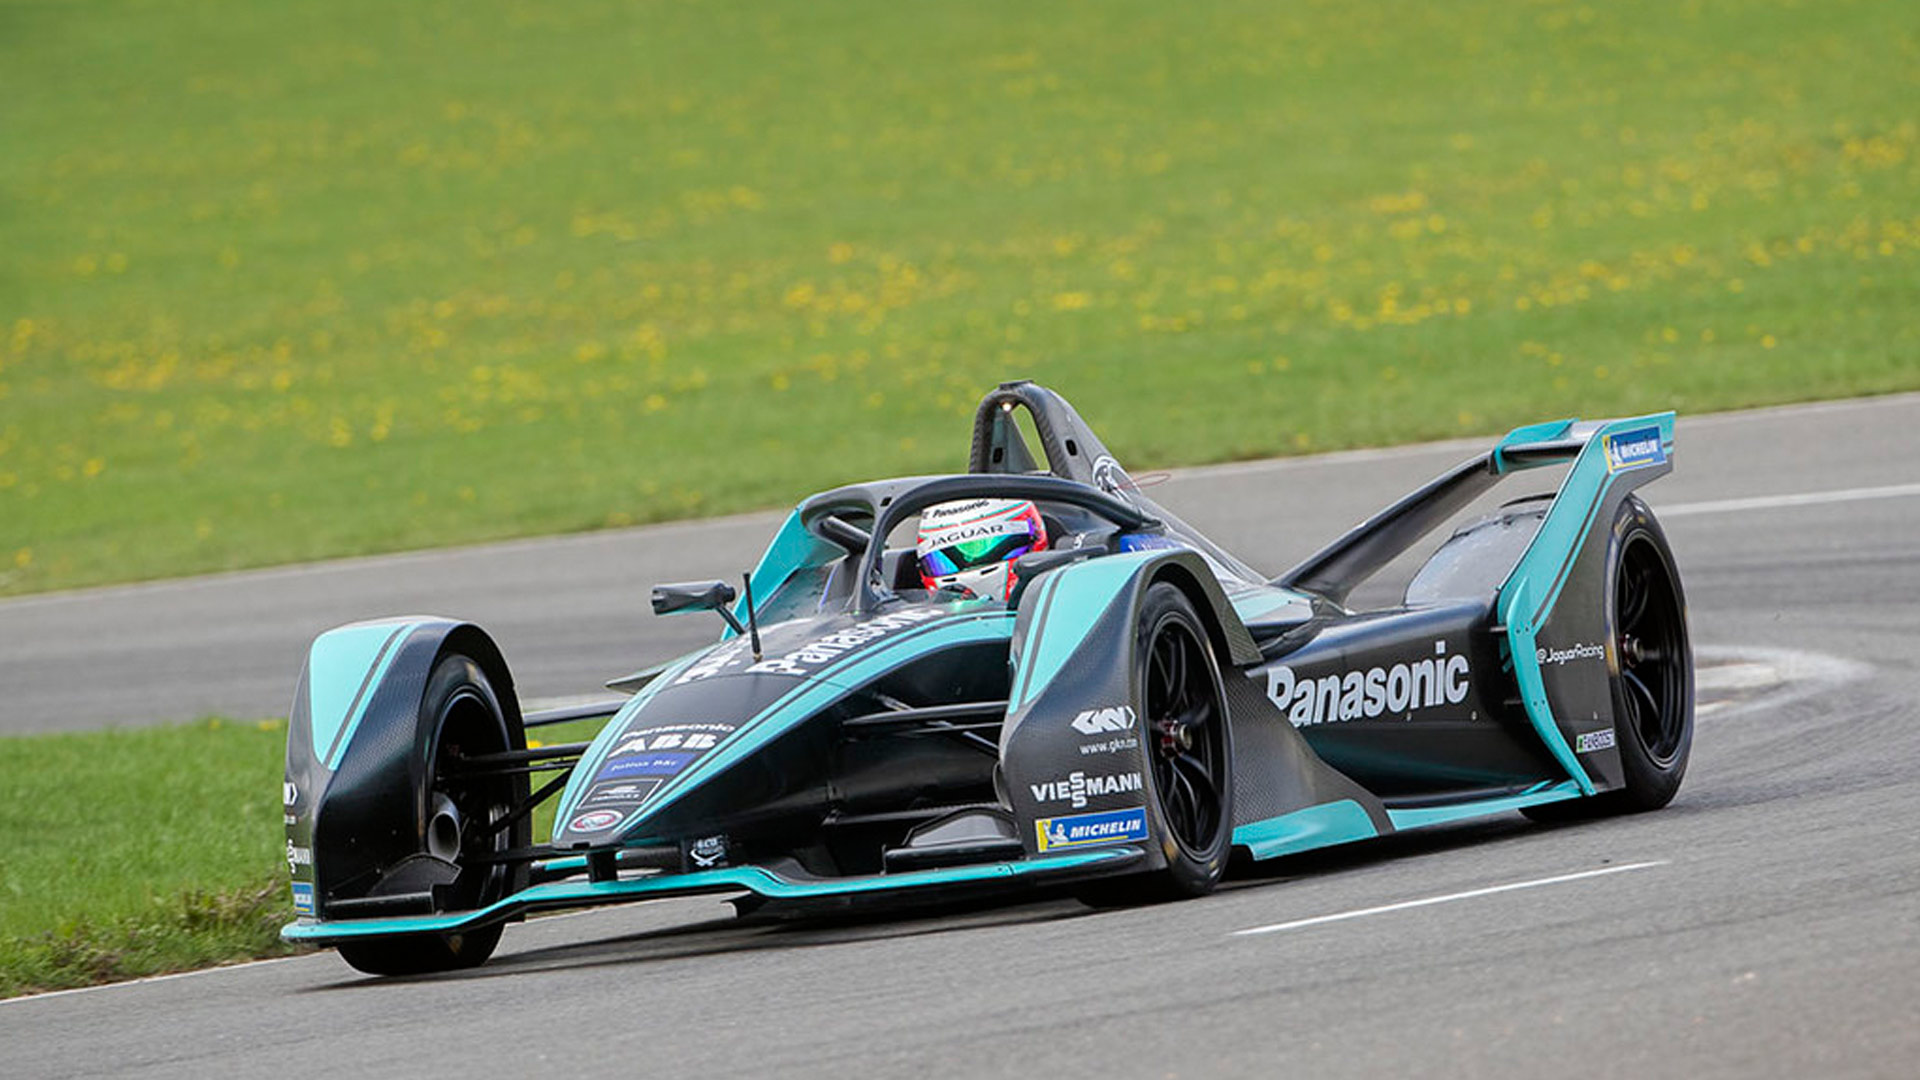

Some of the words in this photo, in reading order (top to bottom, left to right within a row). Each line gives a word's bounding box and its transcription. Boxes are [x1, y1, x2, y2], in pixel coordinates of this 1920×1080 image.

[1620, 439, 1659, 459] MICHELIN
[932, 499, 990, 518] Panasonic
[929, 524, 1005, 548] JAGUAR
[1536, 642, 1605, 666] @JaguarRacing
[1267, 640, 1470, 728] Panasonic
[606, 733, 717, 759] ABB
[1031, 771, 1143, 808] VIESSMANN
[1069, 819, 1142, 839] MICHELIN
